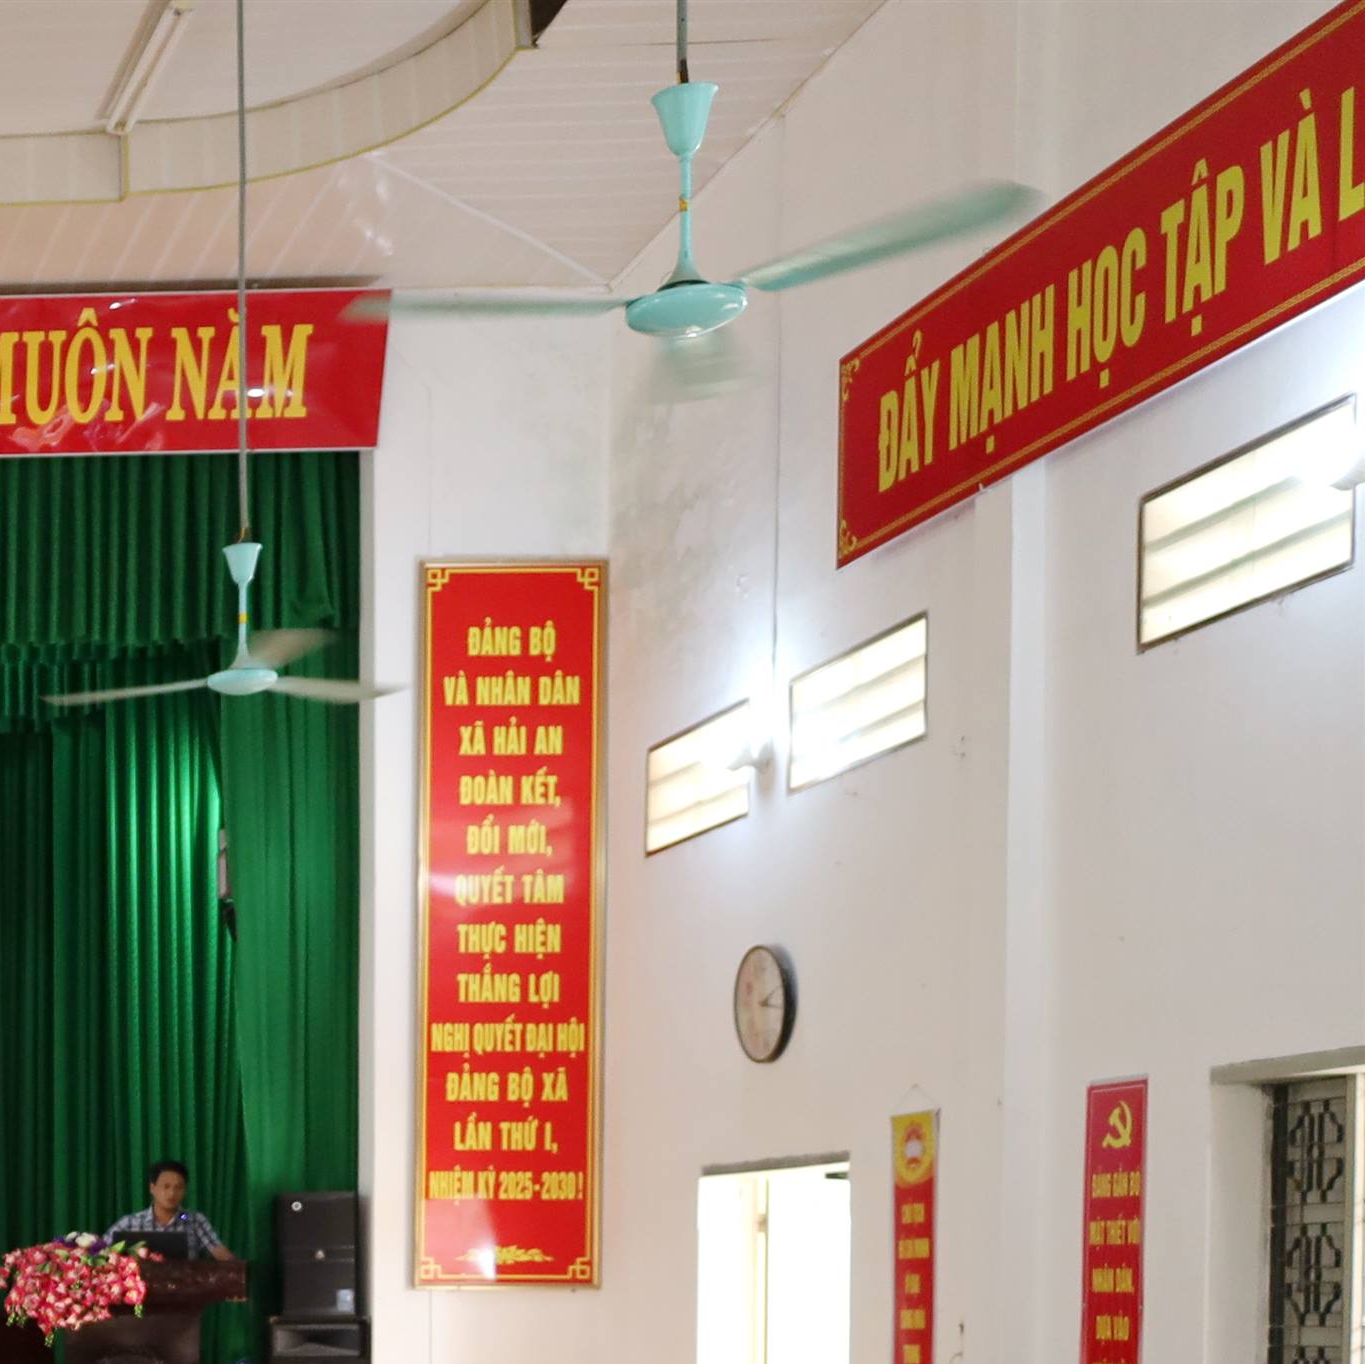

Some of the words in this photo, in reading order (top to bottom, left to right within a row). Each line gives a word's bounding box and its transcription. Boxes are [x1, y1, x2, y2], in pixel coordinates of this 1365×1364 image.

[877, 329, 940, 494] ĐẨY
[947, 283, 1056, 455] MẠNH
[1065, 227, 1148, 391] HỌC
[1161, 157, 1246, 338] TẬP
[1258, 87, 1324, 266] VÀ
[167, 306, 314, 422] NĂM
[468, 617, 521, 656] ĐẢNG
[529, 621, 556, 661] BỘ
[444, 671, 468, 705] VÀ
[476, 671, 531, 705] NHÂN
[539, 670, 580, 705] DÂN
[459, 721, 485, 755] XÃ
[493, 717, 527, 755] HẢI
[534, 726, 562, 754] AN
[459, 770, 513, 805] ĐOÀN
[521, 767, 562, 808] KẾT,
[466, 815, 500, 854] ĐỔI
[508, 819, 552, 857] MỚI,
[457, 922, 506, 959] THỰC
[514, 918, 561, 959] HIỆN
[457, 963, 520, 1002] THẮNG
[529, 971, 560, 1008] LỢI
[431, 1023, 470, 1057] NGHỊ
[472, 1014, 523, 1055] QUYẾT
[525, 1023, 553, 1057] ĐẠI
[557, 1017, 585, 1057] HỘI
[446, 1063, 499, 1101] ĐẢNG
[507, 1067, 533, 1107] BỘ
[542, 1067, 568, 1101] XÃ
[454, 1112, 492, 1150] LẦN
[499, 1116, 538, 1150] THỨ
[544, 1122, 558, 1153] I,
